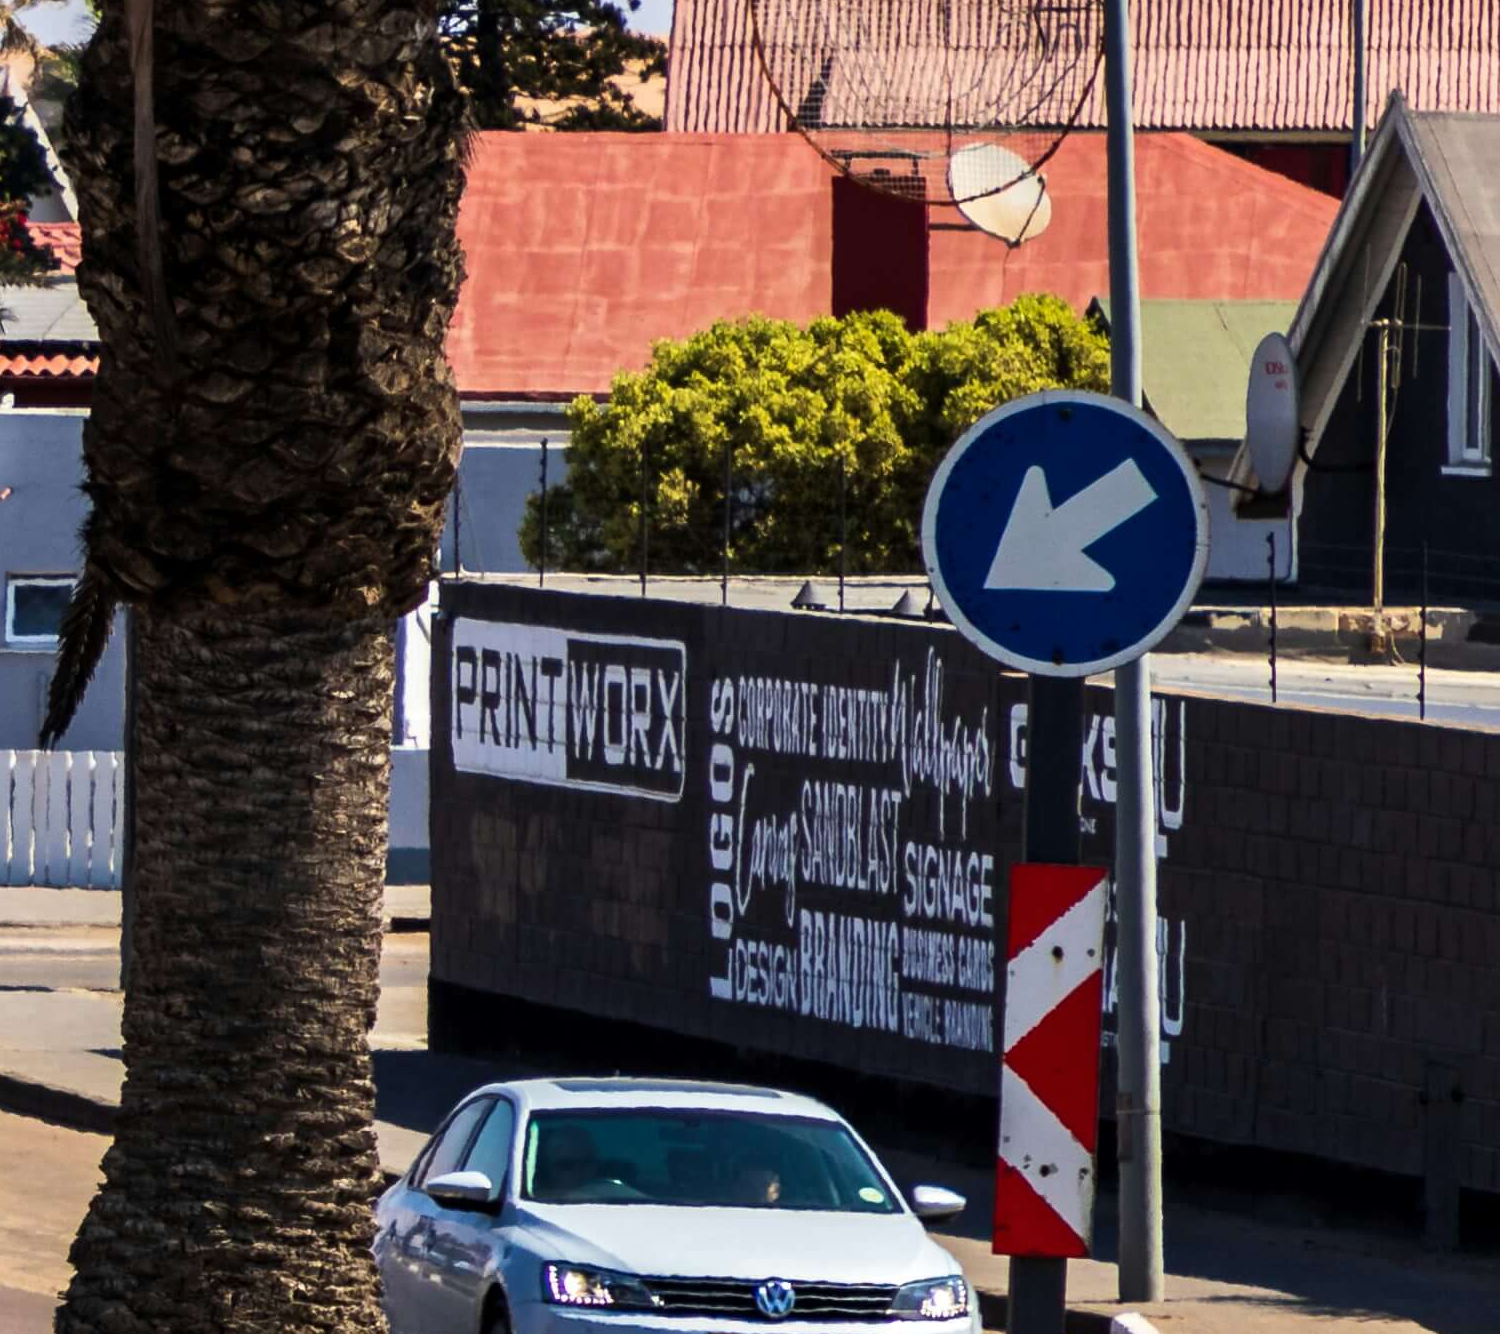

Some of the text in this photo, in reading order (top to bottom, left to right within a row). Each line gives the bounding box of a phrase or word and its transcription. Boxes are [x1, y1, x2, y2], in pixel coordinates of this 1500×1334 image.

[738, 676, 889, 763] CORPORATE IDENTITY
[891, 646, 995, 842] Wallpaper
[710, 677, 734, 1001] LOGOS
[801, 779, 902, 895] SANDBLAST
[904, 841, 994, 927] SIGNAGE
[735, 938, 798, 1011] DESIGN
[801, 908, 899, 1033] BRANDING
[902, 926, 994, 993] BUSINESS CARDS
